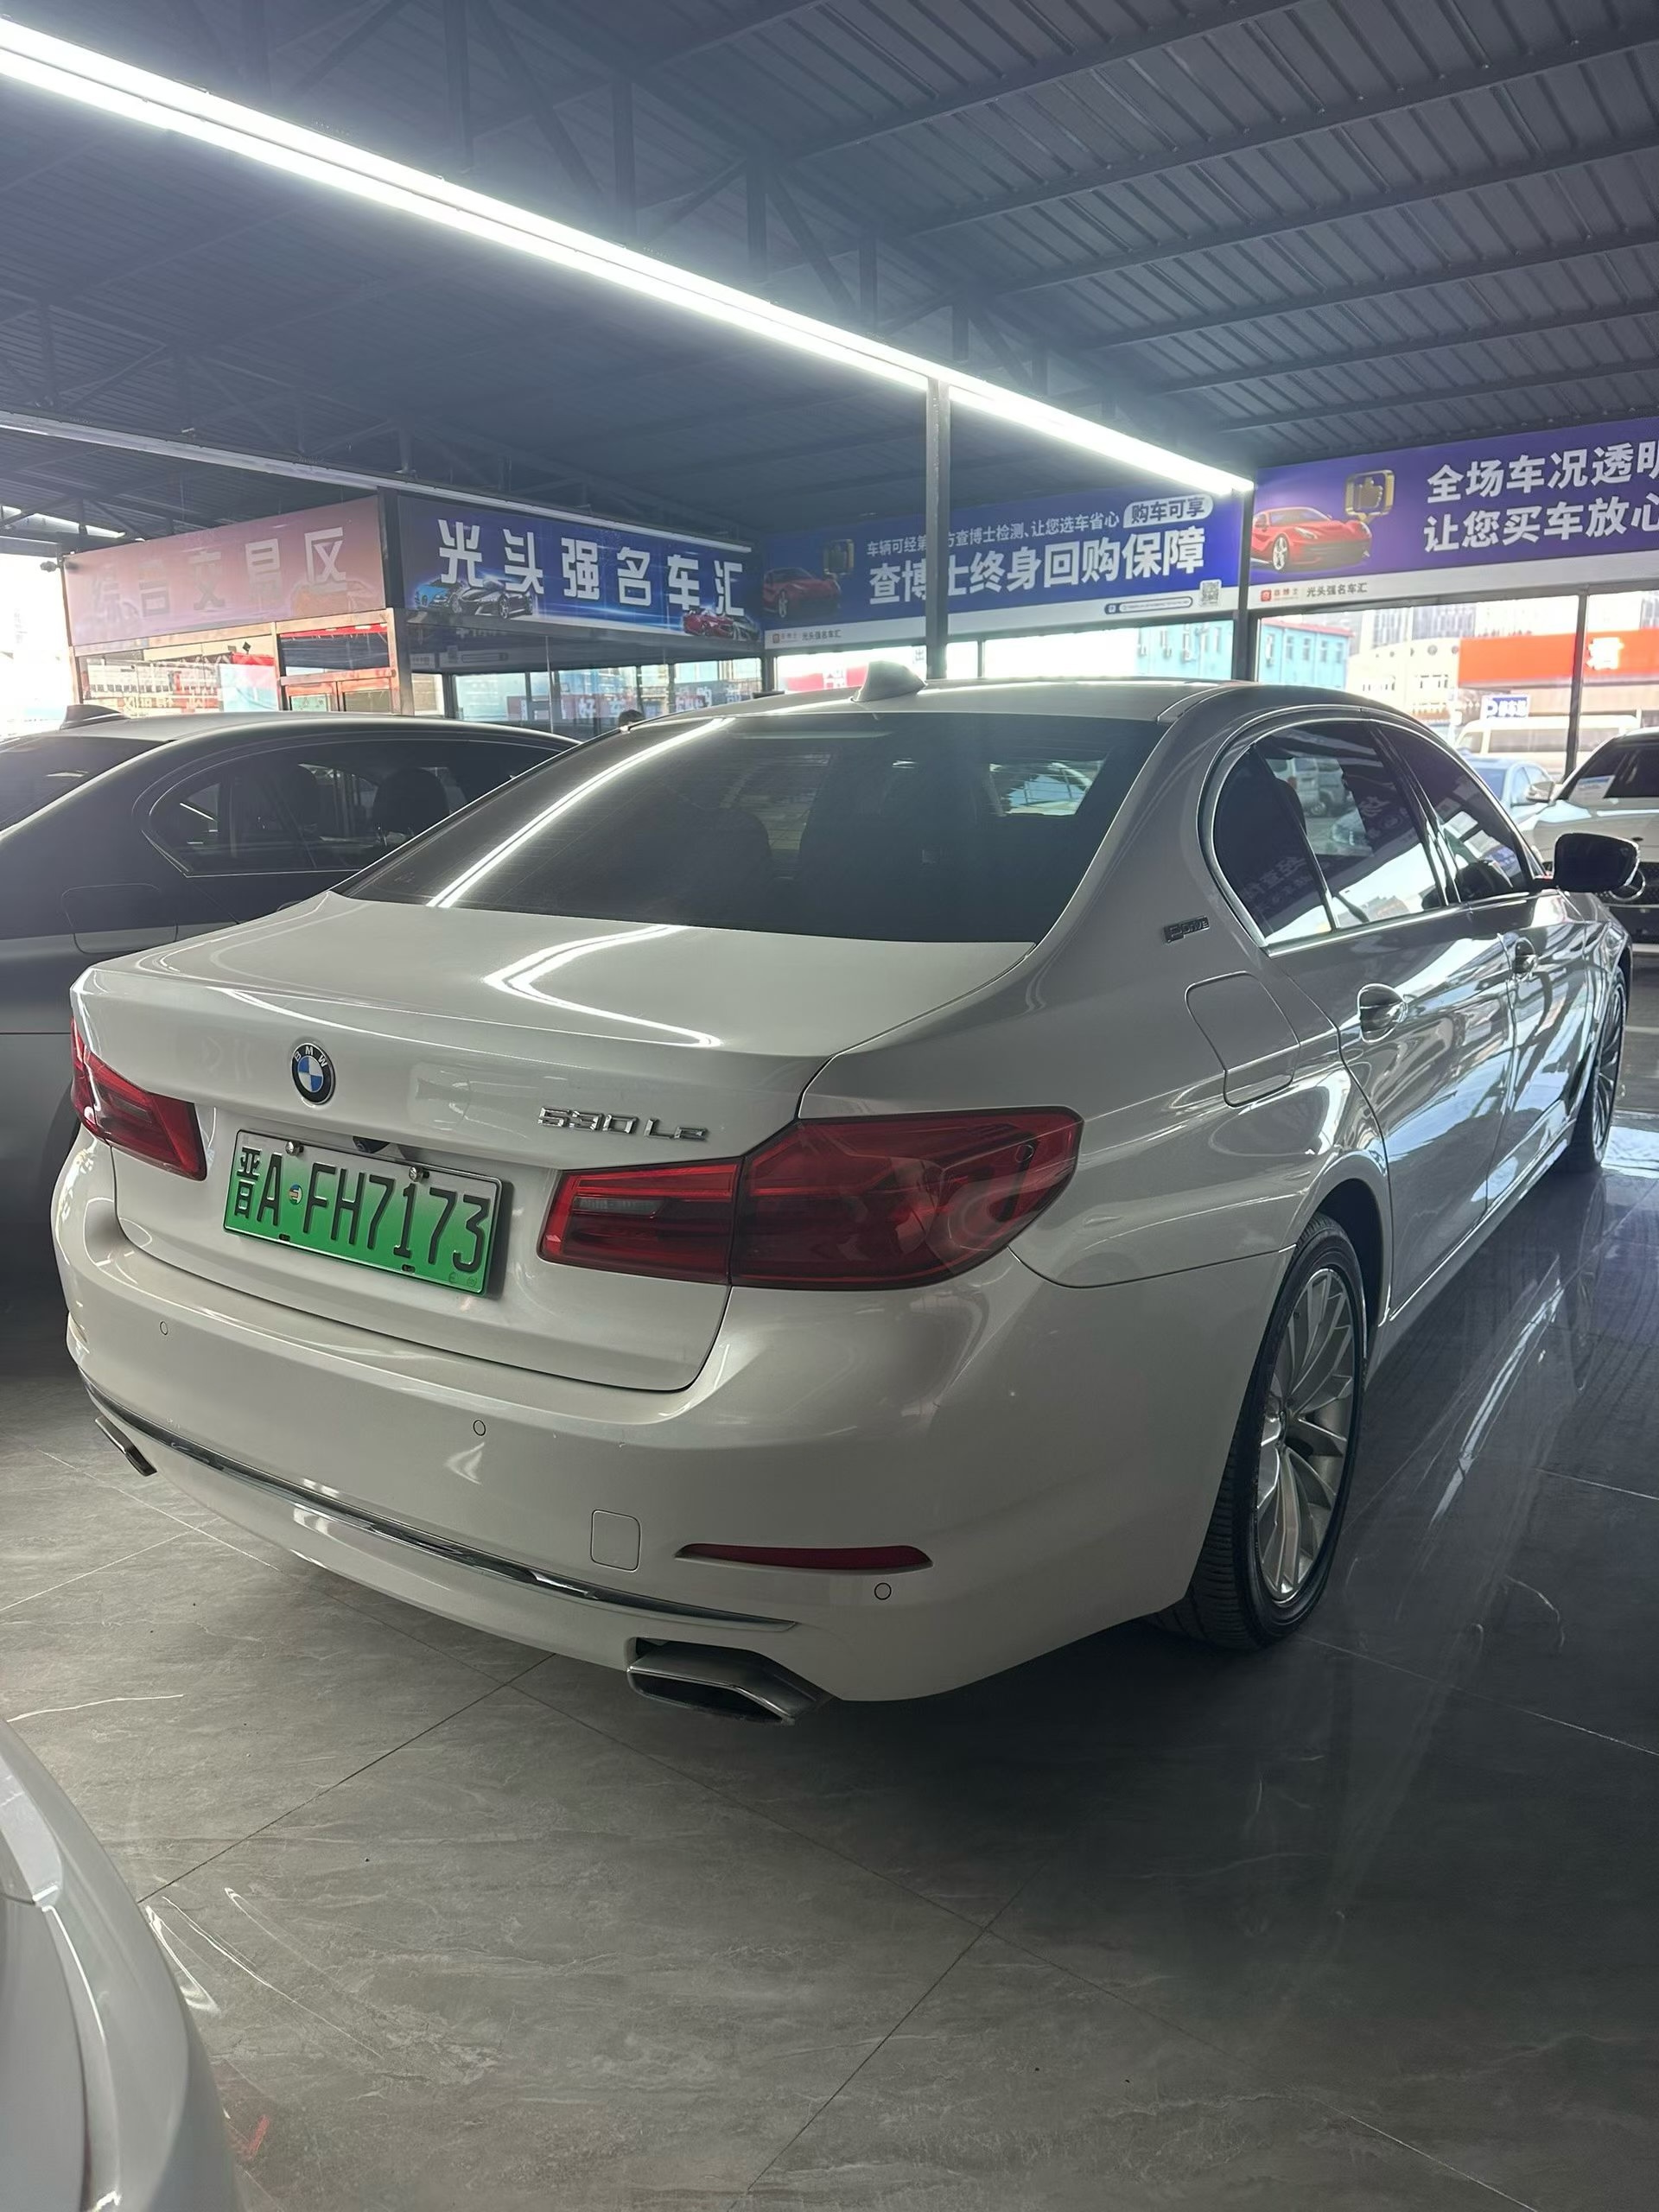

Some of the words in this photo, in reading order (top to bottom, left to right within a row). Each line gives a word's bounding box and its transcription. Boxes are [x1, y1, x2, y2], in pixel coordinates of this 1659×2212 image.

[1427, 439, 1659, 504] 全场车况透明
[1131, 497, 1205, 524] 购车可享
[1423, 493, 1659, 553] 让您买车放心
[438, 518, 745, 617] 光头强名车汇
[869, 525, 1205, 604] 查博士终身回购保障
[1306, 582, 1368, 597] 光头强名车汇
[294, 1045, 328, 1068] BMW
